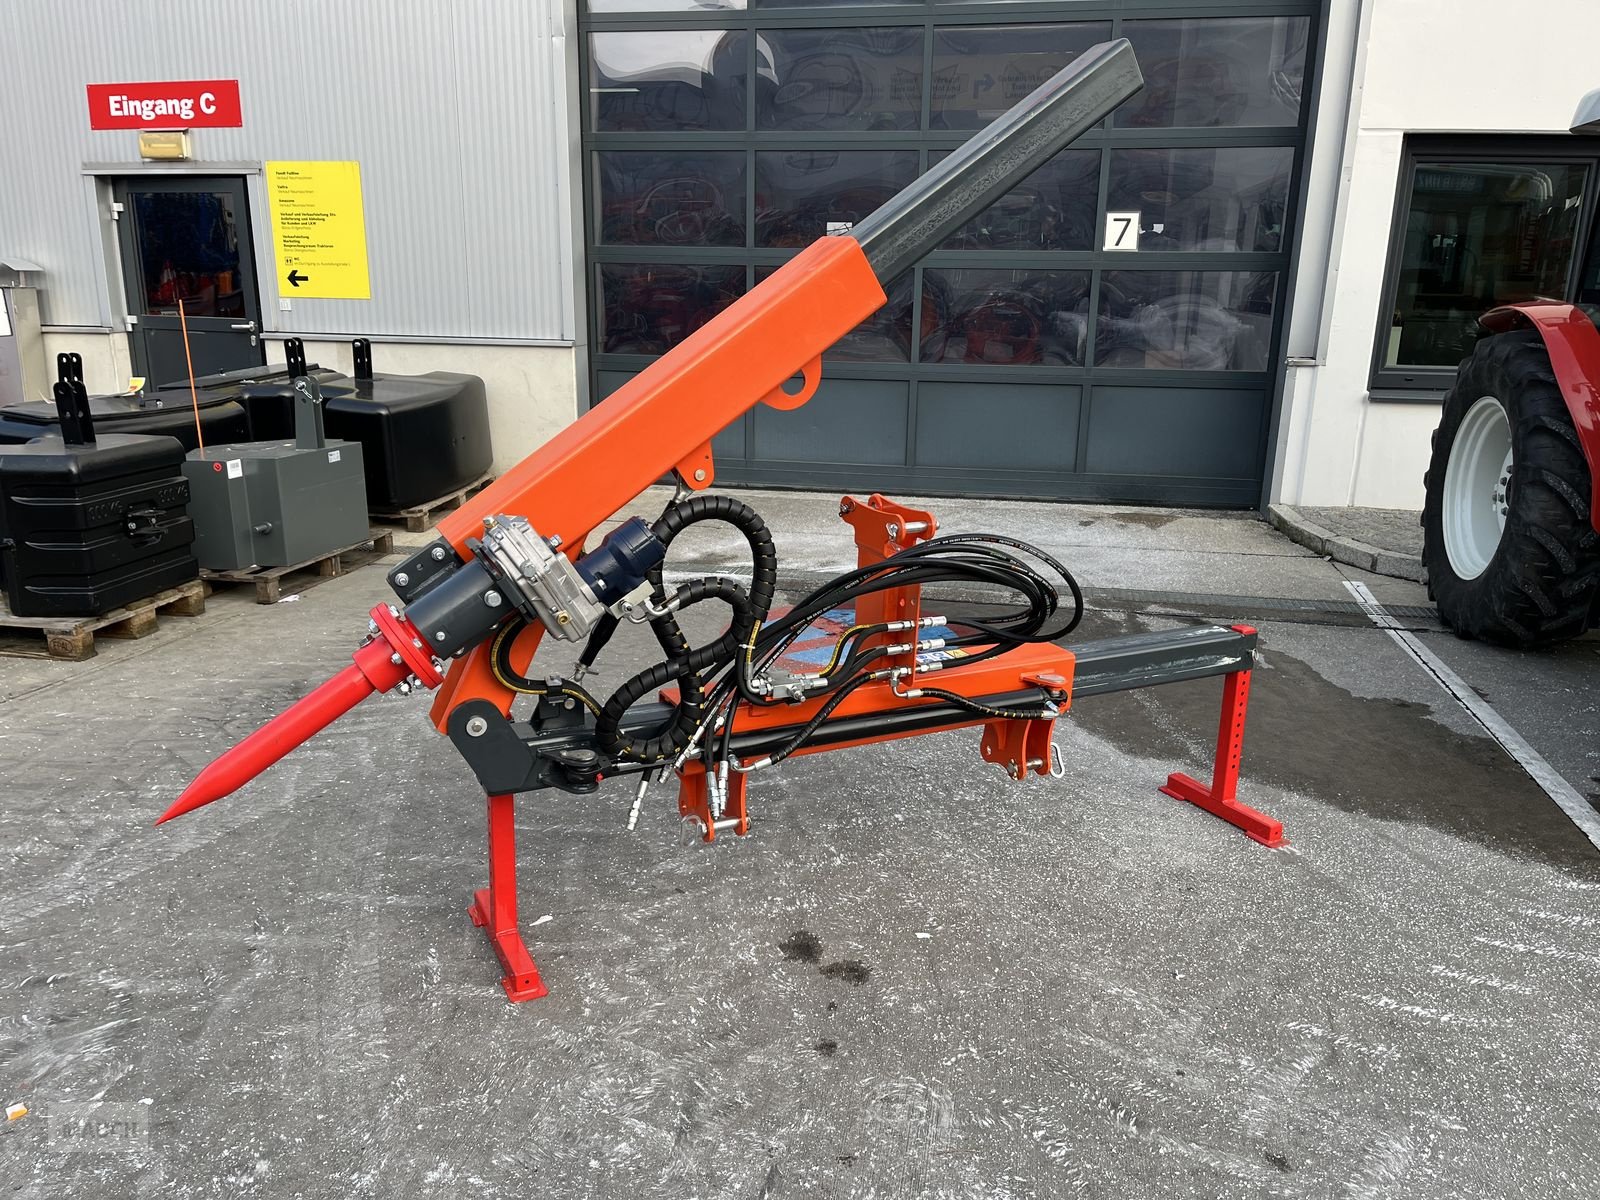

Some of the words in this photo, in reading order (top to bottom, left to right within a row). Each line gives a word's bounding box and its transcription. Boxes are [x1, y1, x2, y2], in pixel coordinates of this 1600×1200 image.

[108, 95, 194, 120] Eingang
[199, 92, 216, 114] C
[1113, 218, 1132, 247] 7
